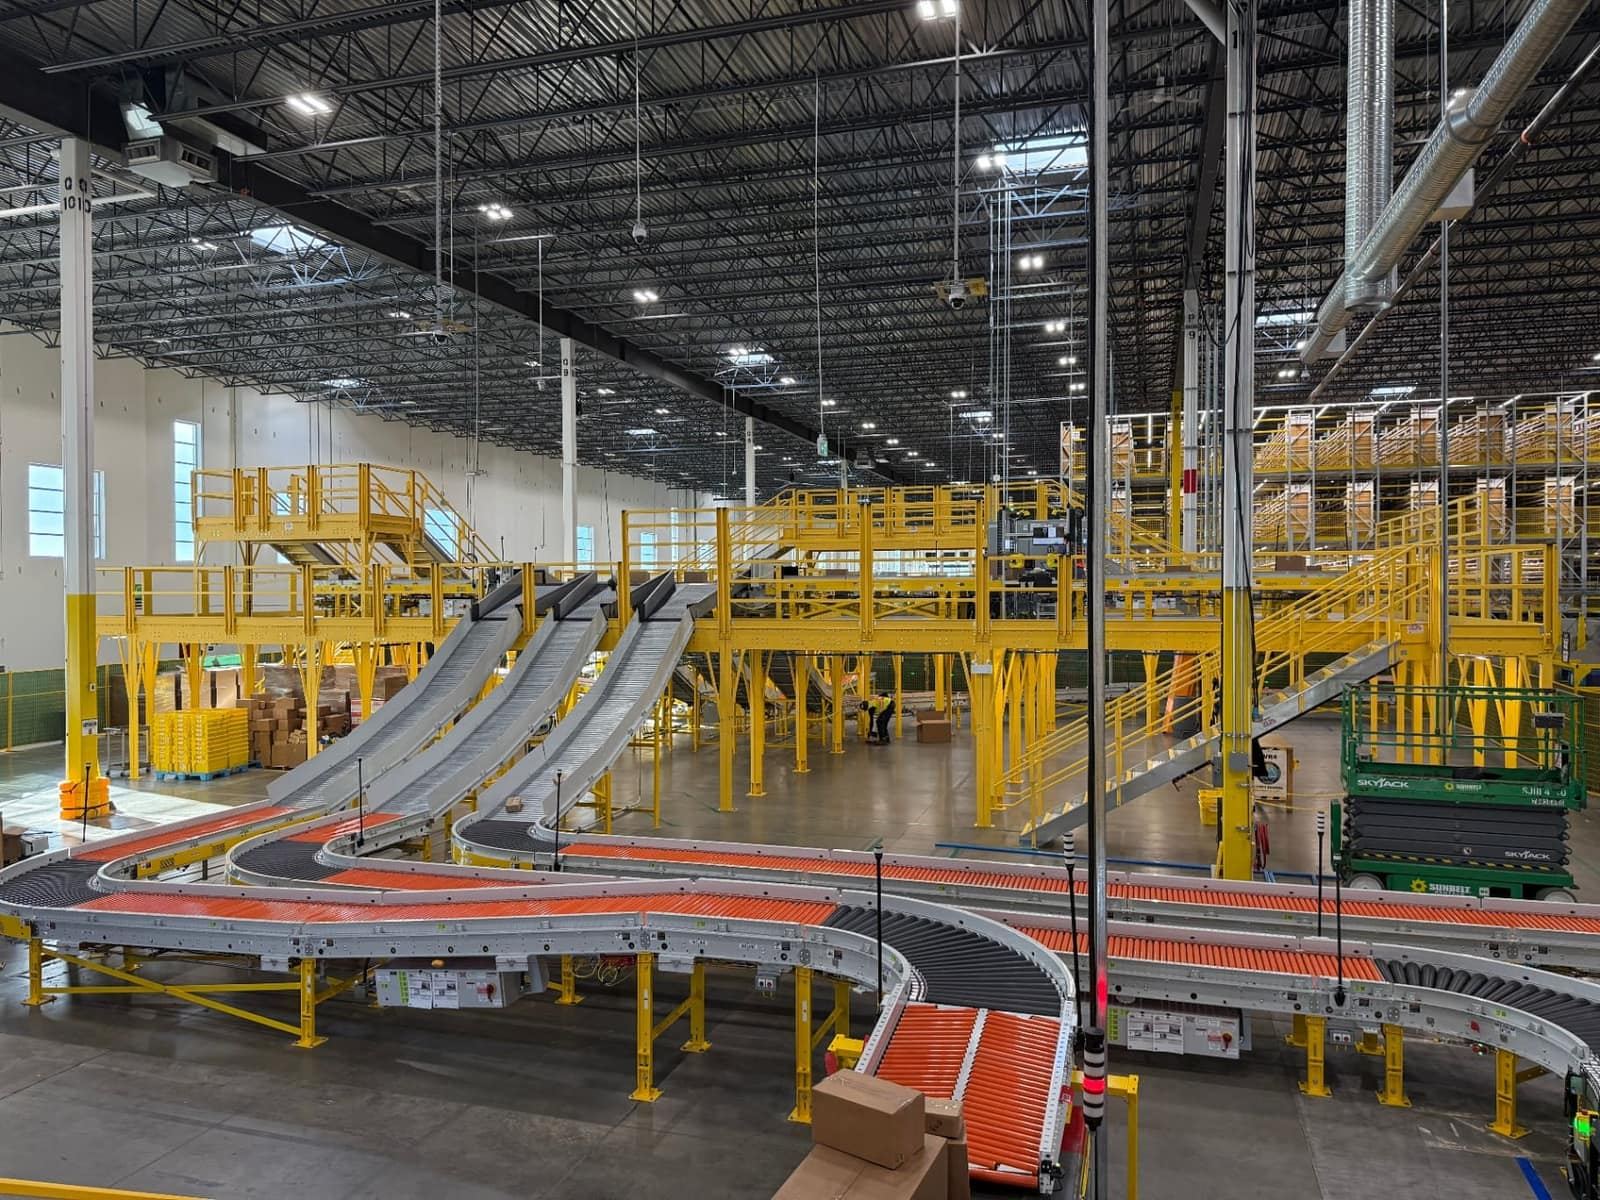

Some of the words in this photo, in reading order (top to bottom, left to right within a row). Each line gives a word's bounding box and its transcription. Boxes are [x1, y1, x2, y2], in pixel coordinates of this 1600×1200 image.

[1357, 778, 1409, 788] SKYJACK
[1504, 850, 1551, 860] SKYJACK
[1429, 883, 1471, 893] SUNBELT
